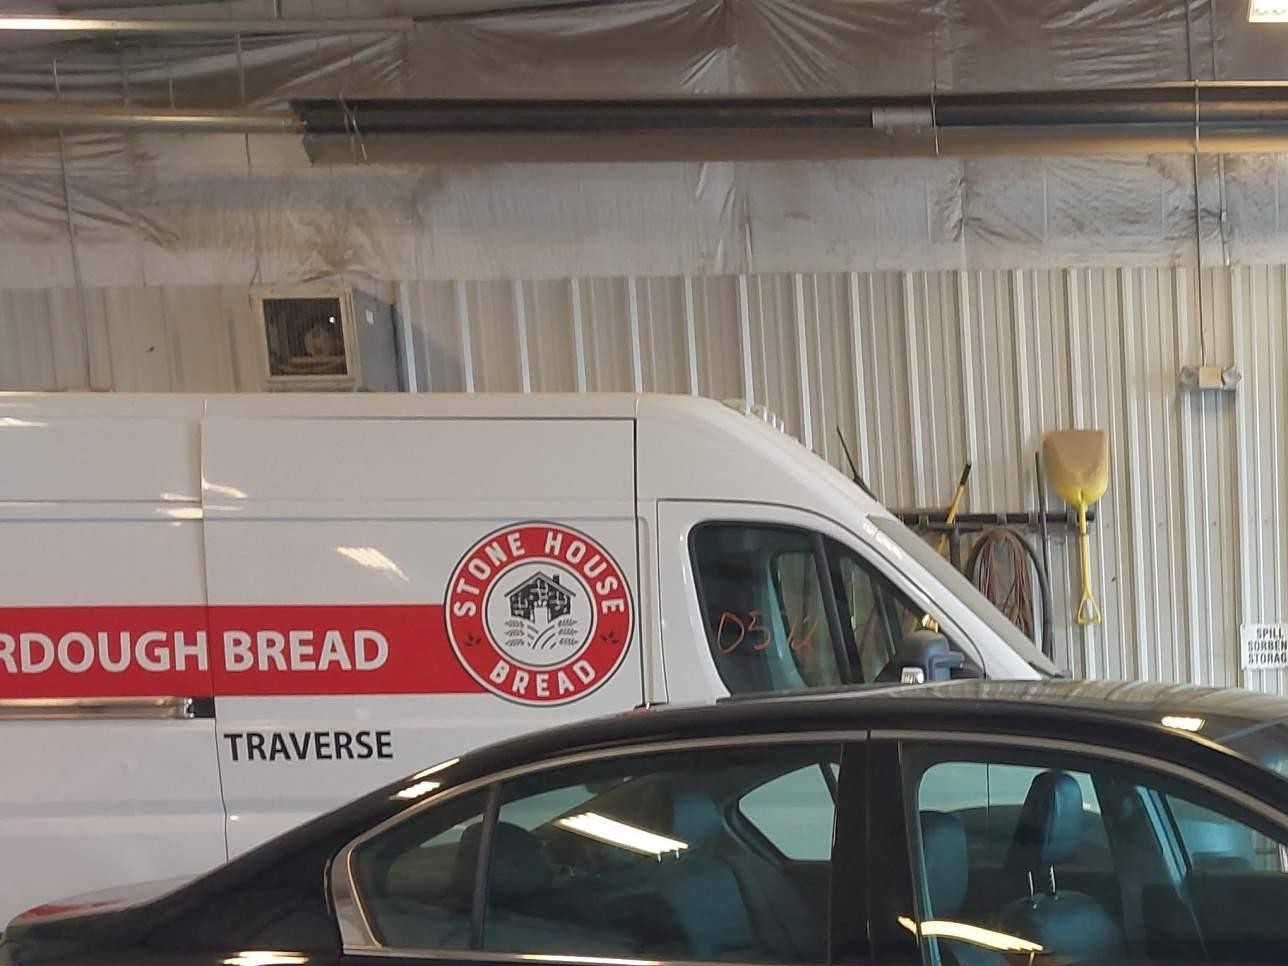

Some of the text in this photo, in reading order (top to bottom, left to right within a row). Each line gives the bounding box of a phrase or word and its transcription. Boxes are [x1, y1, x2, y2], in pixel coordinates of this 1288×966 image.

[454, 531, 625, 618] STONE HOUSE
[224, 629, 390, 672] BREAD
[1256, 627, 1284, 639] SPILL
[489, 660, 597, 696] BREAD
[224, 731, 394, 761] TRAVERSE
